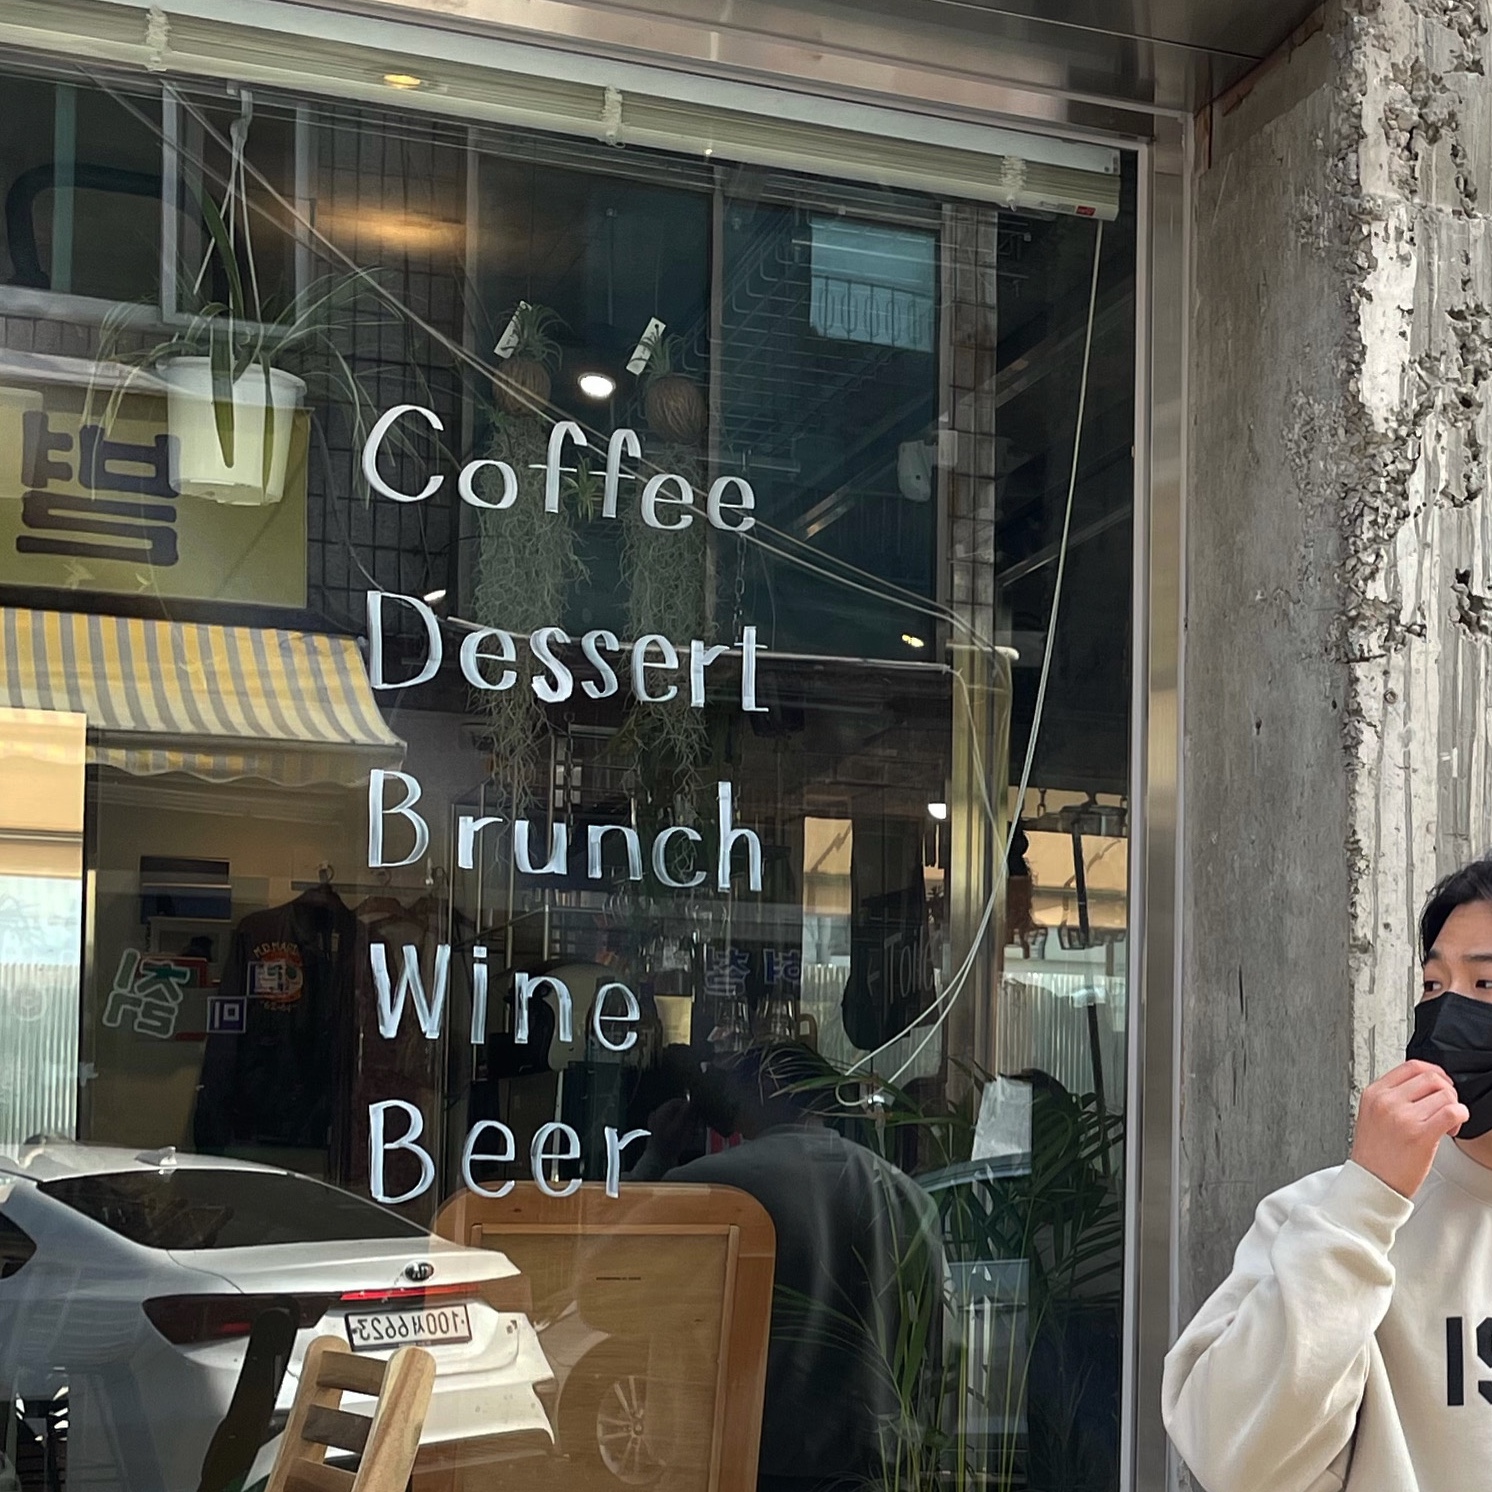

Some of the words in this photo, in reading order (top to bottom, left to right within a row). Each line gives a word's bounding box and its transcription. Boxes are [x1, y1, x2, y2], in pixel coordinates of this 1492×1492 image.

[361, 403, 758, 533] Coffee
[365, 589, 769, 713] Dessert
[367, 768, 764, 893] Brunch
[369, 942, 642, 1052] Wine
[882, 924, 944, 1006] Toile
[368, 1098, 651, 1204] Beer
